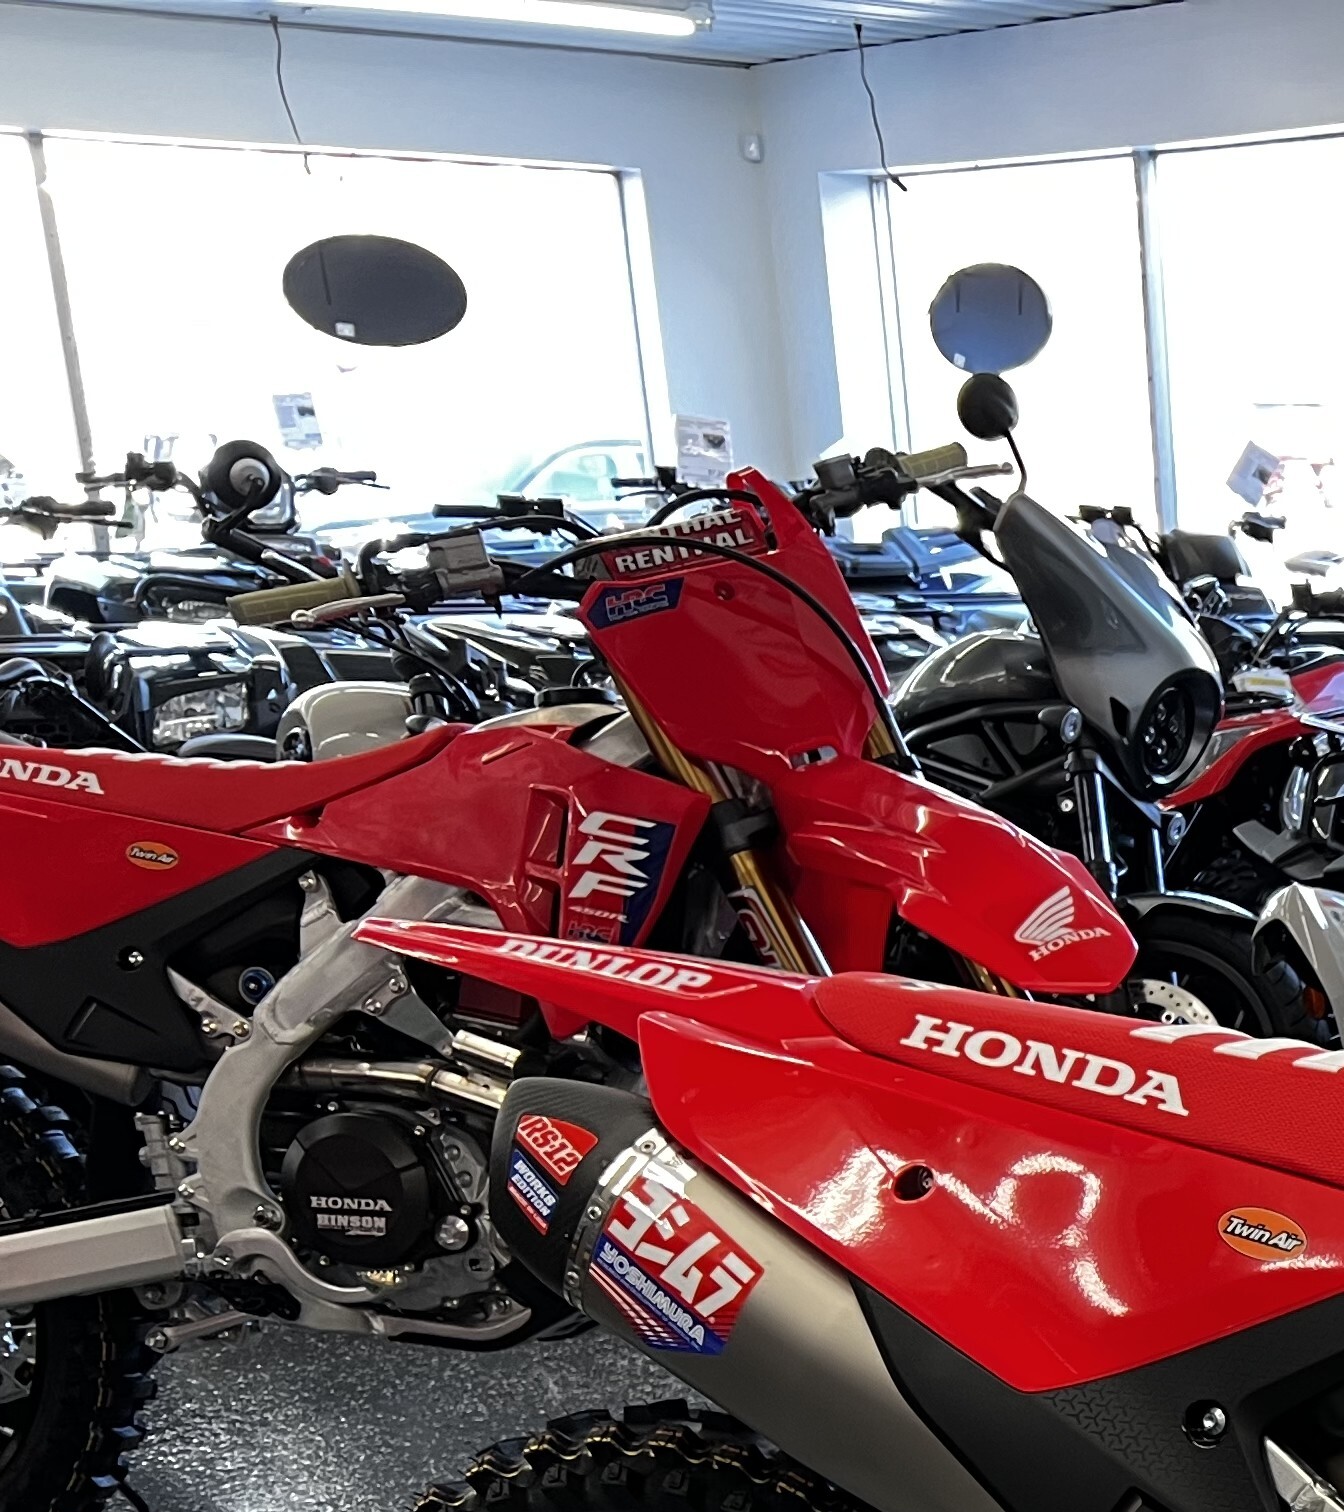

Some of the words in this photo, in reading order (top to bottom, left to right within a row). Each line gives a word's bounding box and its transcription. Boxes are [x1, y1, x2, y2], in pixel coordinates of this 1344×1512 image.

[0, 758, 105, 795] NDA
[567, 810, 658, 898] CRF
[568, 905, 629, 923] 450R
[497, 938, 713, 994] DUNLOP
[1028, 927, 1112, 962] HONDA
[900, 1013, 1190, 1116] HONDA
[310, 1195, 393, 1211] HONDA
[511, 1173, 551, 1217] EDITION
[513, 1159, 556, 1207] WORKS
[317, 1213, 387, 1229] HINSON
[1226, 1216, 1271, 1242] Twin
[1268, 1232, 1302, 1250] Air
[608, 1177, 756, 1318] ヨシムラ
[600, 1241, 706, 1347] YOSHIMURA
